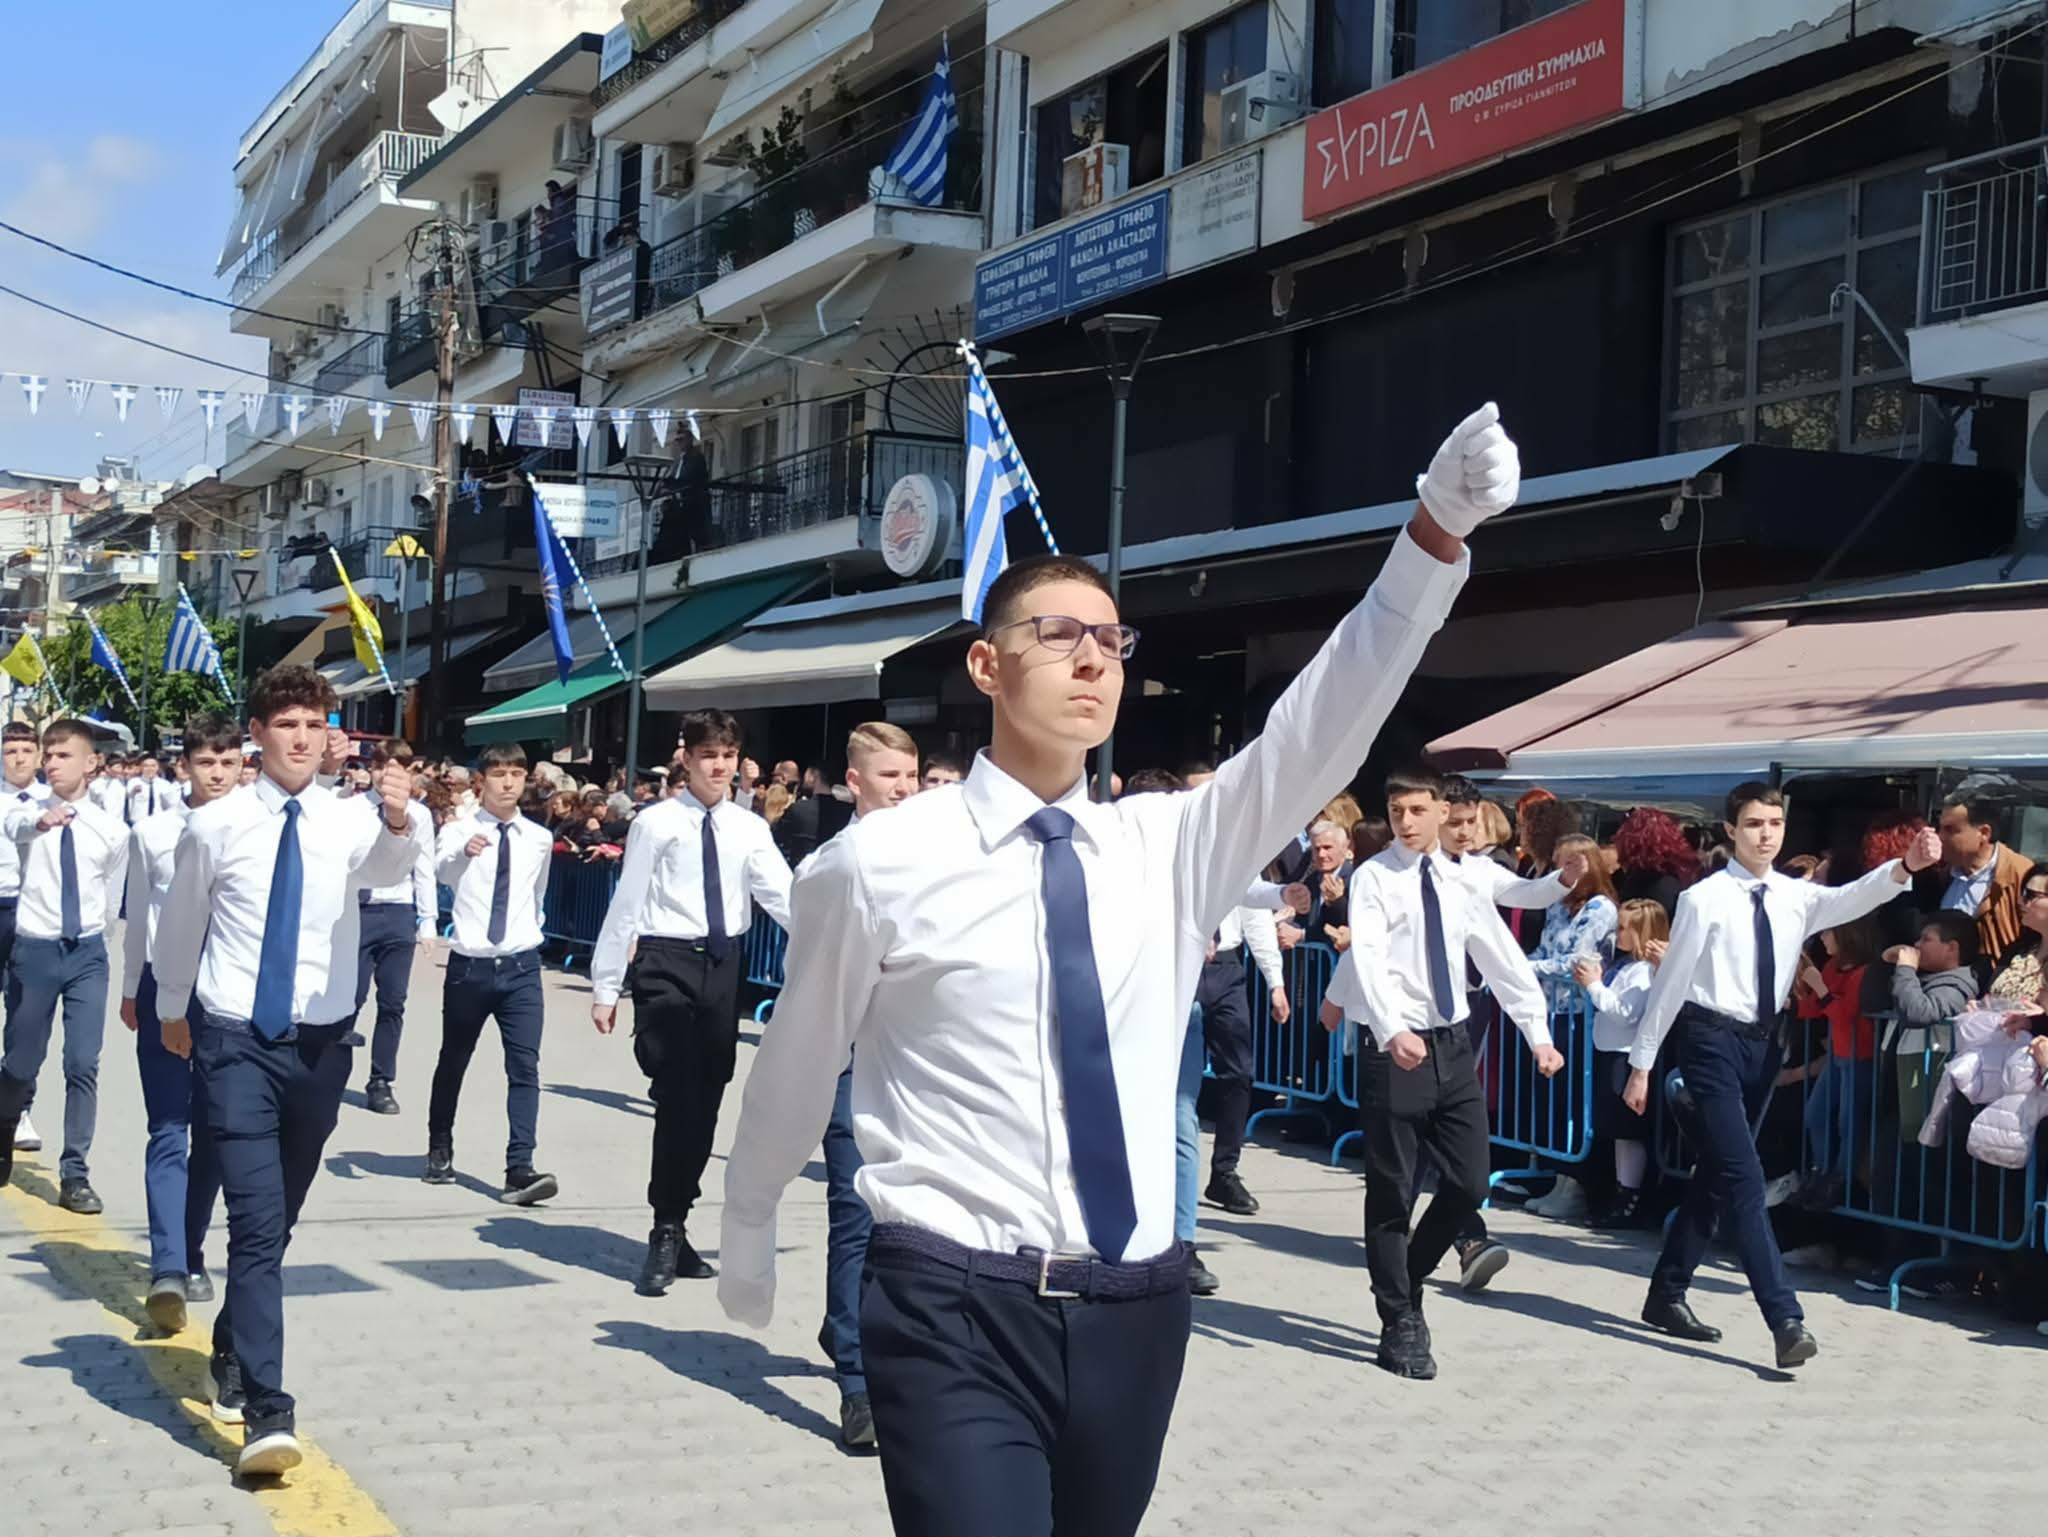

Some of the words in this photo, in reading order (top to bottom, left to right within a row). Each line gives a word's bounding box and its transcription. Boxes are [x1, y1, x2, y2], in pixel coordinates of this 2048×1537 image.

[1449, 66, 1534, 114] ΠΡΟΟΔΕΥΤΙΚΗ
[1537, 38, 1606, 81] ΣΥΜΜΑΧΙΑ
[1316, 102, 1435, 190] ΣΥΡΙΖΑ
